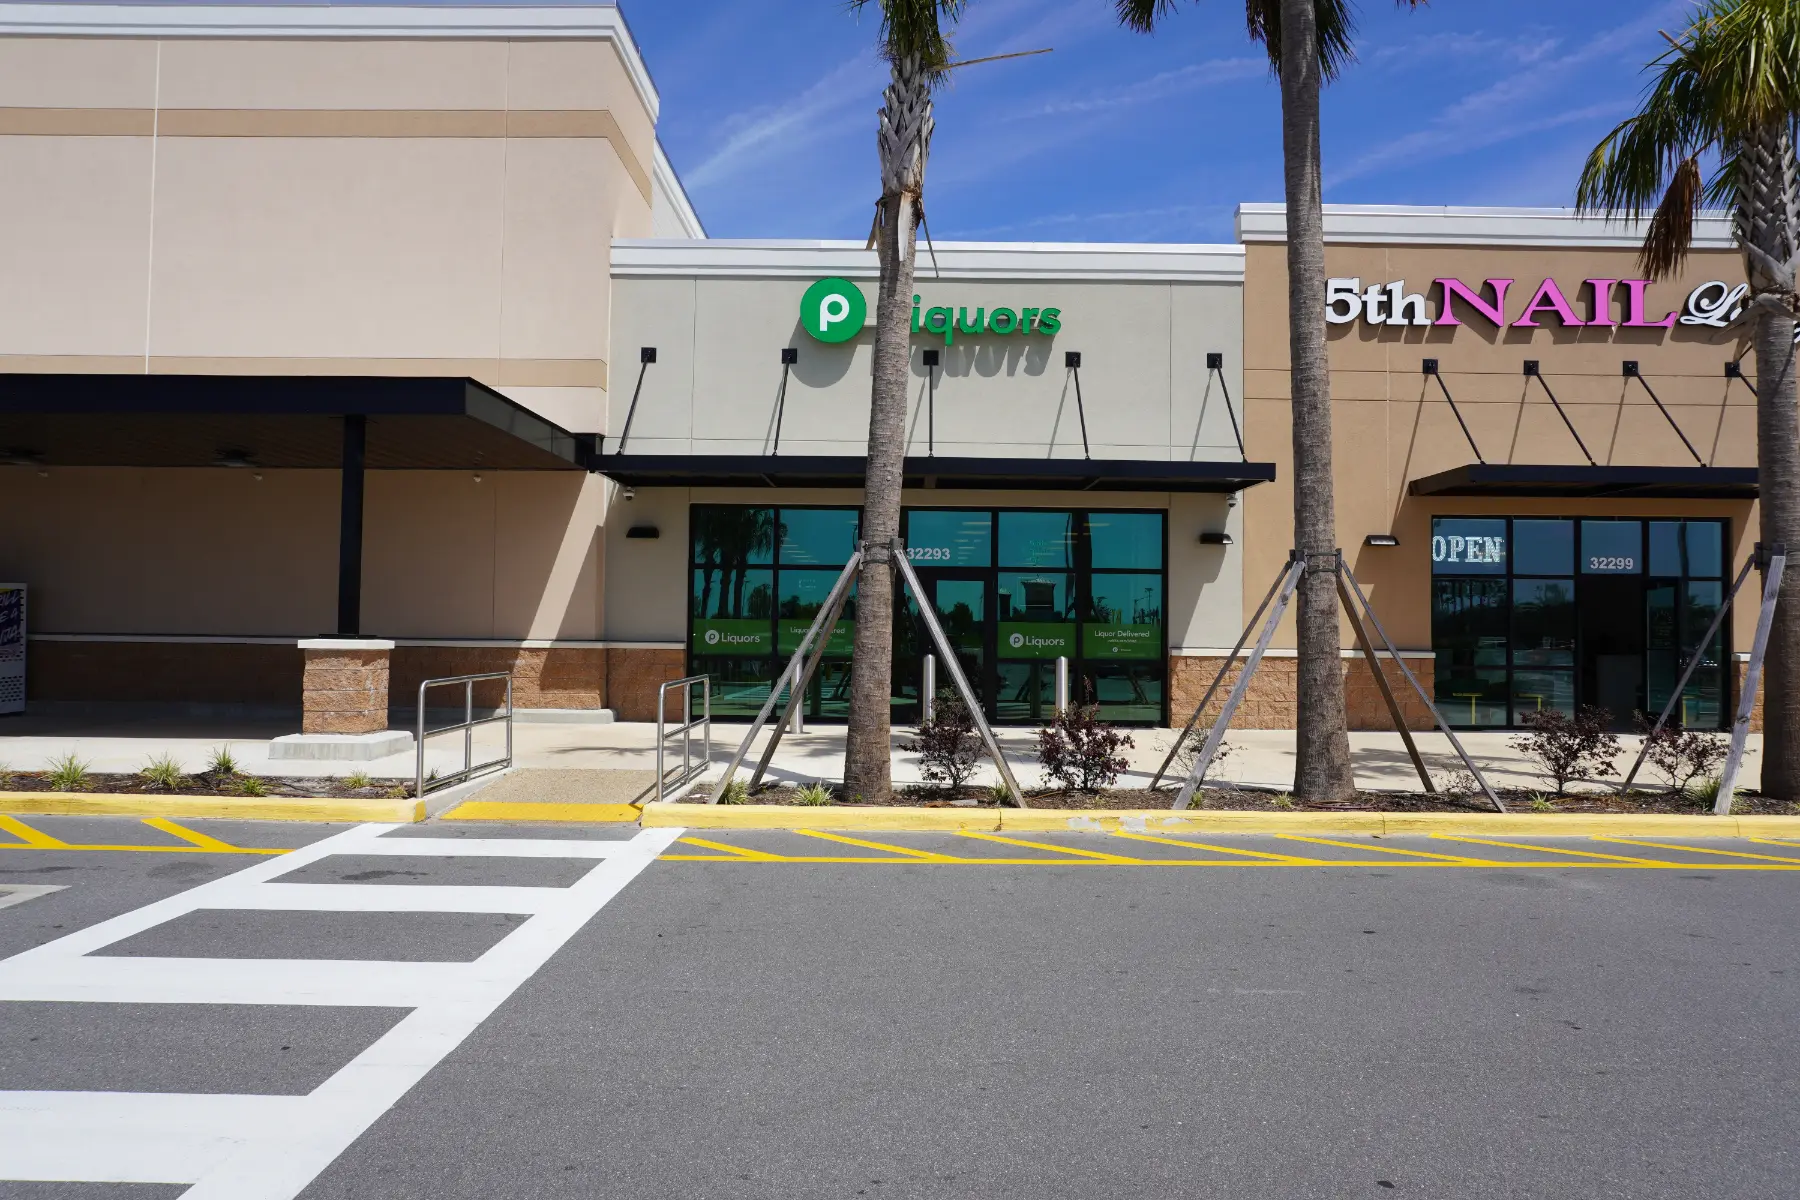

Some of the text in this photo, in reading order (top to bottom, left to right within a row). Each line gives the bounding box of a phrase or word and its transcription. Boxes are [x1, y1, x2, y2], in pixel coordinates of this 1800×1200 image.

[1325, 276, 1431, 326] 5th
[1433, 277, 1677, 328] NAIL
[911, 294, 1062, 346] iquors
[906, 547, 951, 560] 32293
[1432, 536, 1503, 563] OPEN
[1590, 557, 1634, 570] 32299
[790, 626, 809, 635] Liquo
[1094, 630, 1150, 640] Liquor Delivered
[721, 633, 761, 645] Liquors
[1025, 636, 1065, 648] Liquors
